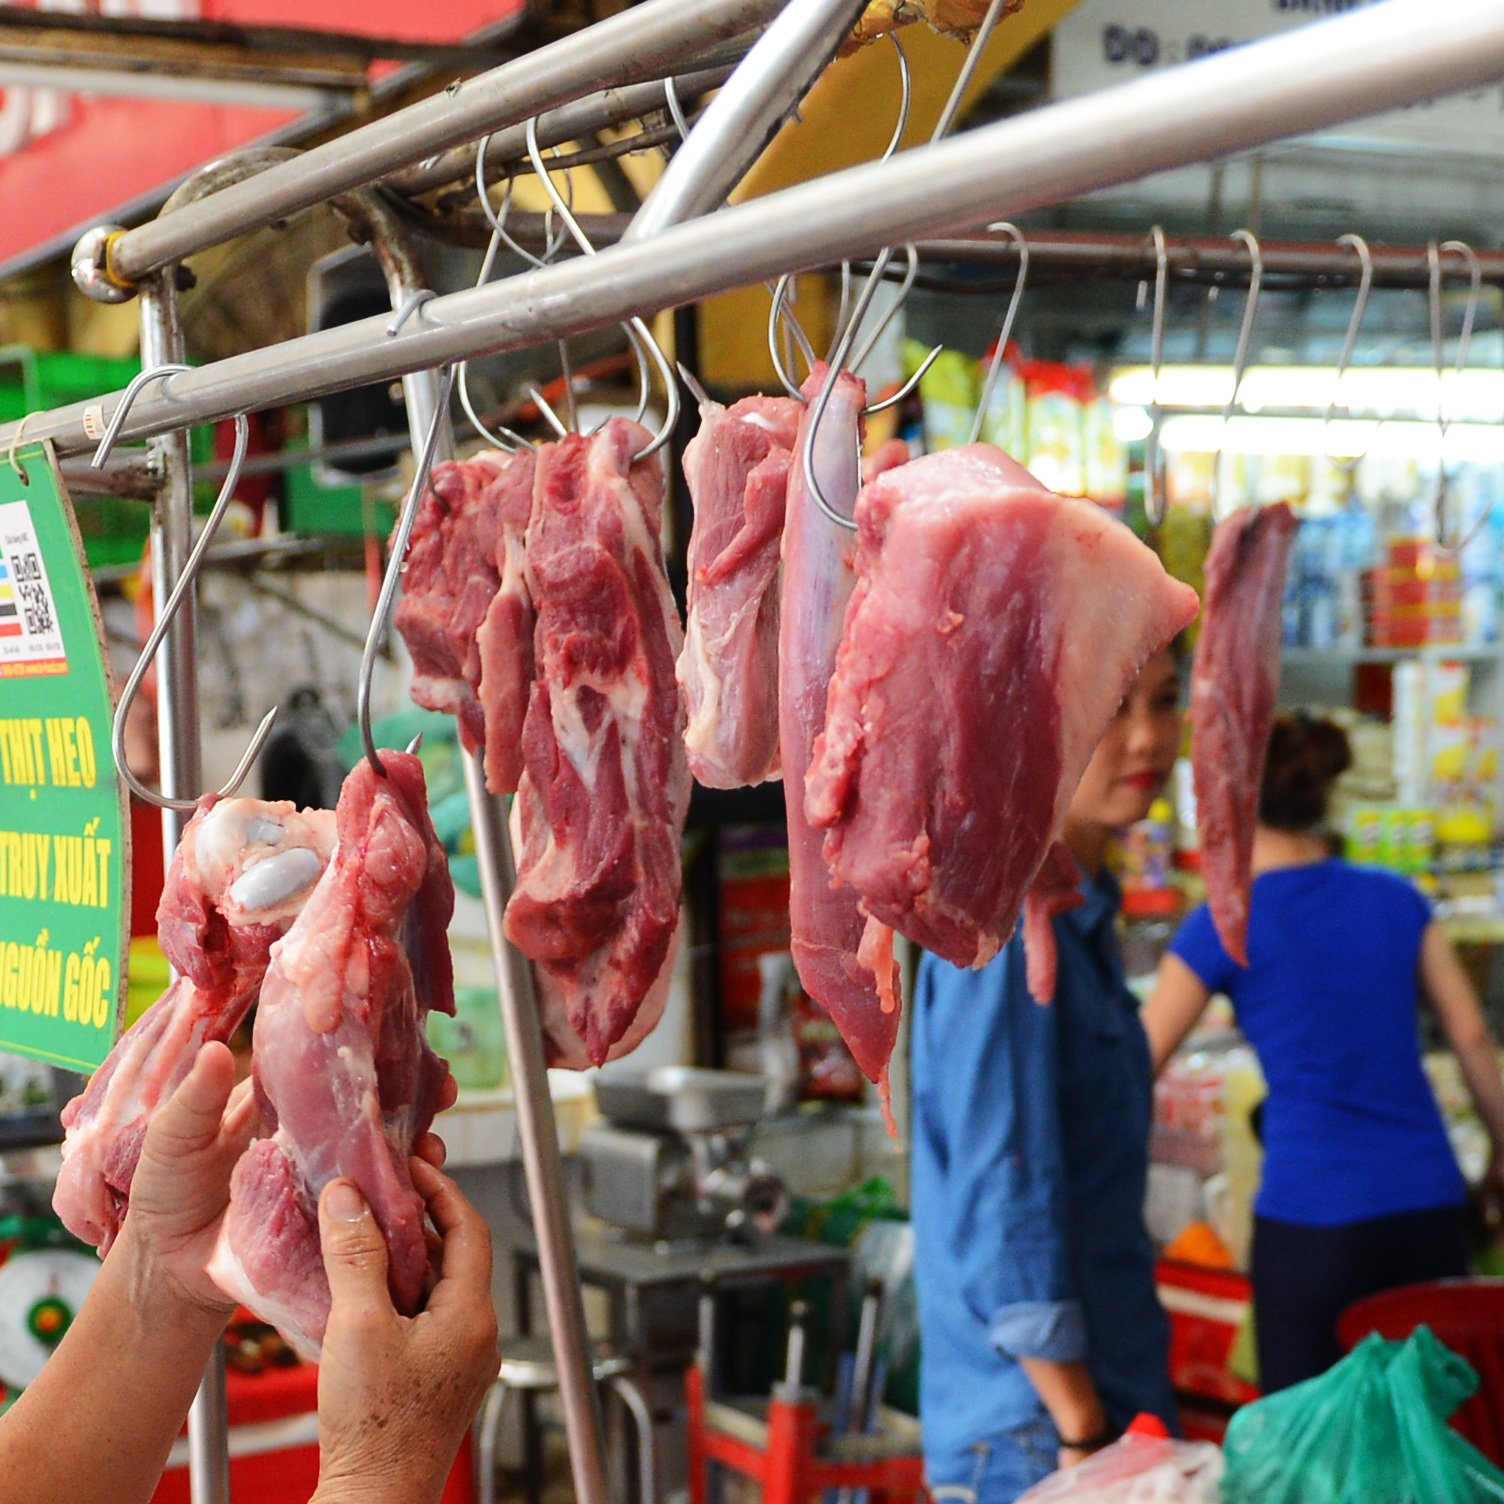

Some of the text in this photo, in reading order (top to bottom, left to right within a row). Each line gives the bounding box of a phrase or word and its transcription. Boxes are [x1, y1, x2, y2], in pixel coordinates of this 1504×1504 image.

[45, 716, 97, 788] HEO
[53, 816, 111, 908] XUẤT
[63, 936, 110, 1029] GỐC
